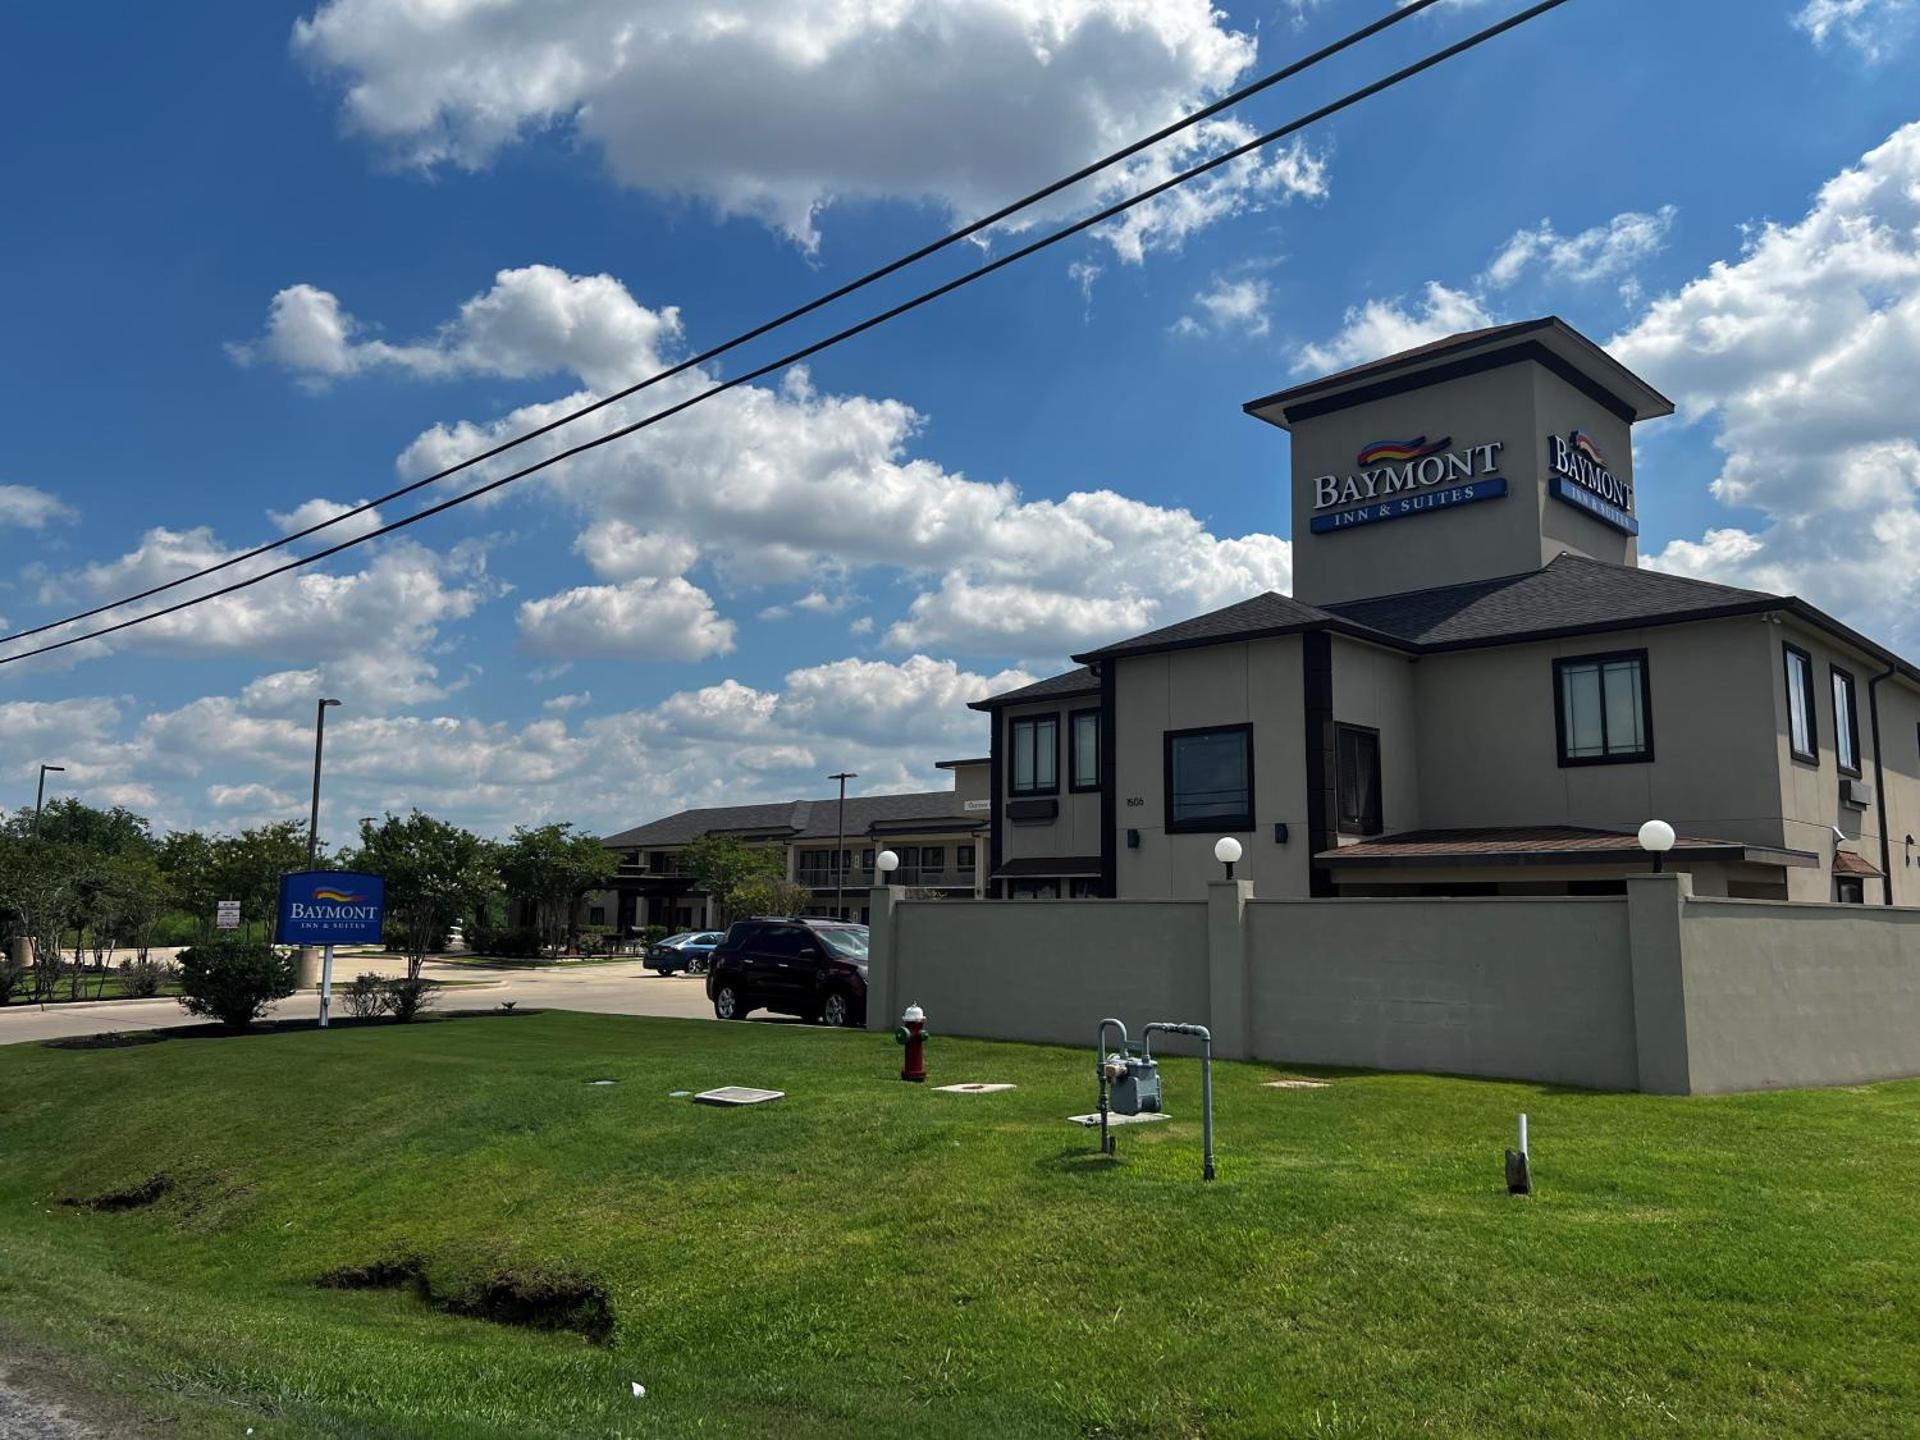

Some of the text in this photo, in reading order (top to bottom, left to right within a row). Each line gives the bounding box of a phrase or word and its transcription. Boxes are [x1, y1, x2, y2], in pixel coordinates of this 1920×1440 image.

[1312, 441, 1502, 510] BAYMONT
[1554, 434, 1632, 511] BAYMONT
[1334, 485, 1475, 527] INN & SUITES
[1571, 486, 1588, 506] INN
[1600, 504, 1630, 528] SUITES
[289, 902, 379, 920] BAYMONT
[301, 922, 319, 930] INN
[333, 922, 366, 930] SUITES
